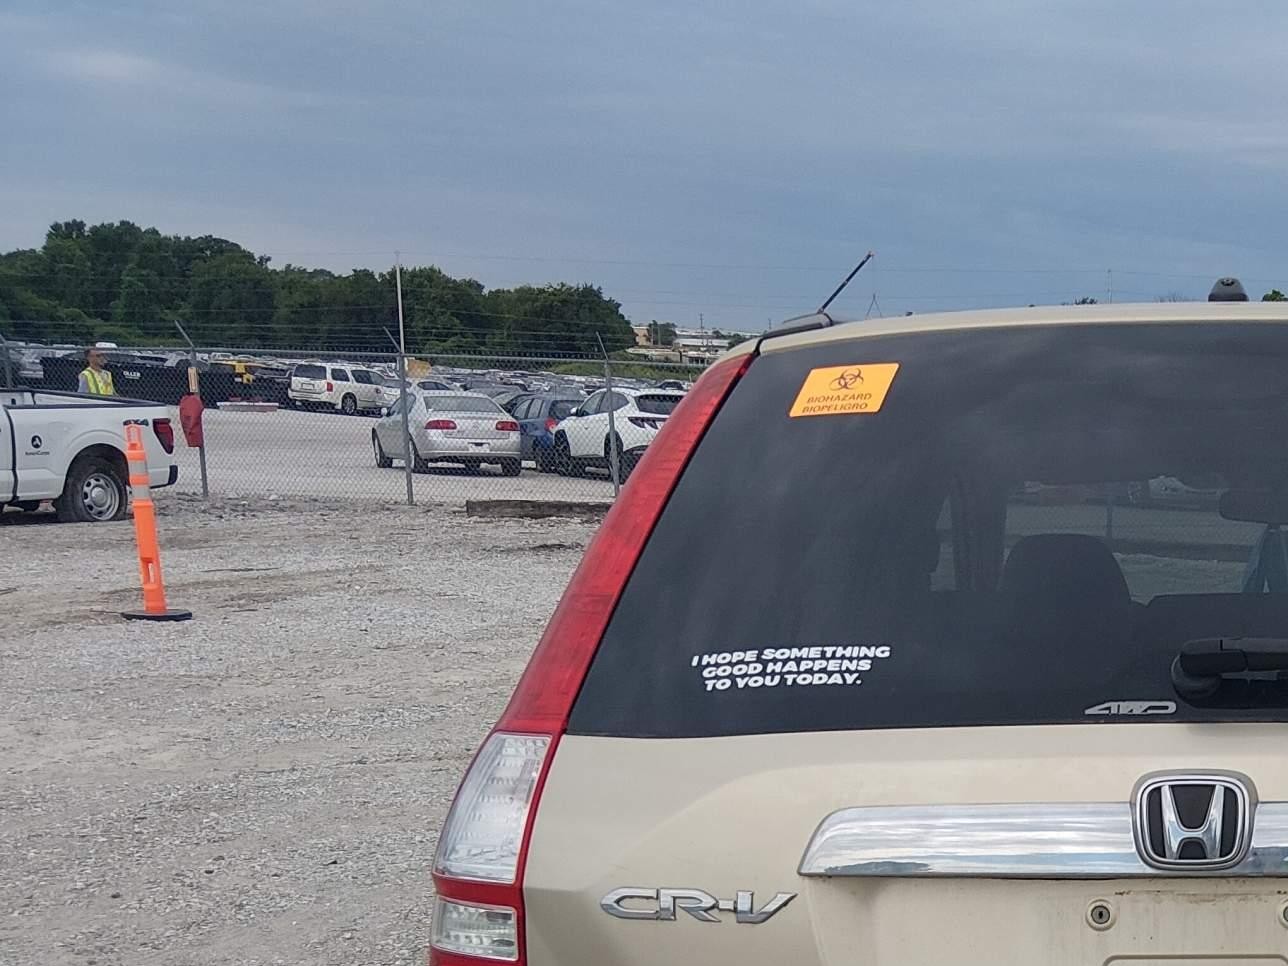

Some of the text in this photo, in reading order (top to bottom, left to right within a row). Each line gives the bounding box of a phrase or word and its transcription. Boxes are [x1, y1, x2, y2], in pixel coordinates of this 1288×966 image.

[803, 402, 867, 413] BIOPELIGRO
[808, 393, 871, 404] BIOHAZARD
[692, 647, 890, 667] I HOPE SOMETHING
[703, 660, 871, 678] GOOD HAPPENS
[705, 673, 861, 691] TO YOU TODAY.
[1085, 701, 1177, 715] 4WD
[600, 887, 798, 924] CR-V
